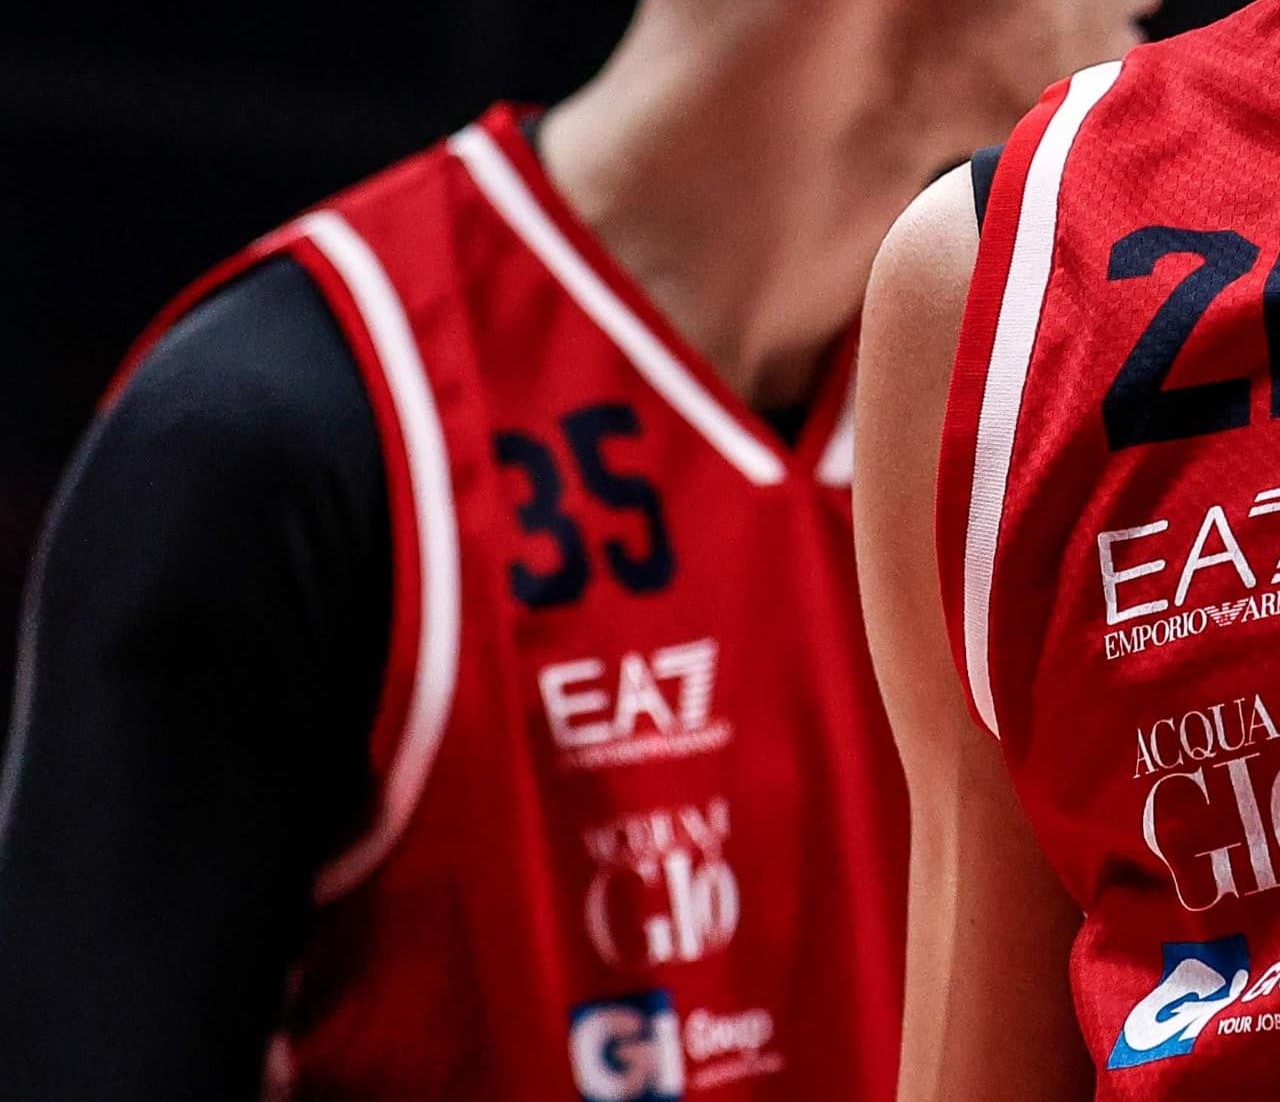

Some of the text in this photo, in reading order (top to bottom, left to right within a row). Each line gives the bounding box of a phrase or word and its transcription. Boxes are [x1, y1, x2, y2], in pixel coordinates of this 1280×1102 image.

[492, 404, 678, 613] 35
[1104, 607, 1206, 660] EMPORIO
[537, 637, 720, 747] EA7
[1217, 1015, 1251, 1035] YOUR
